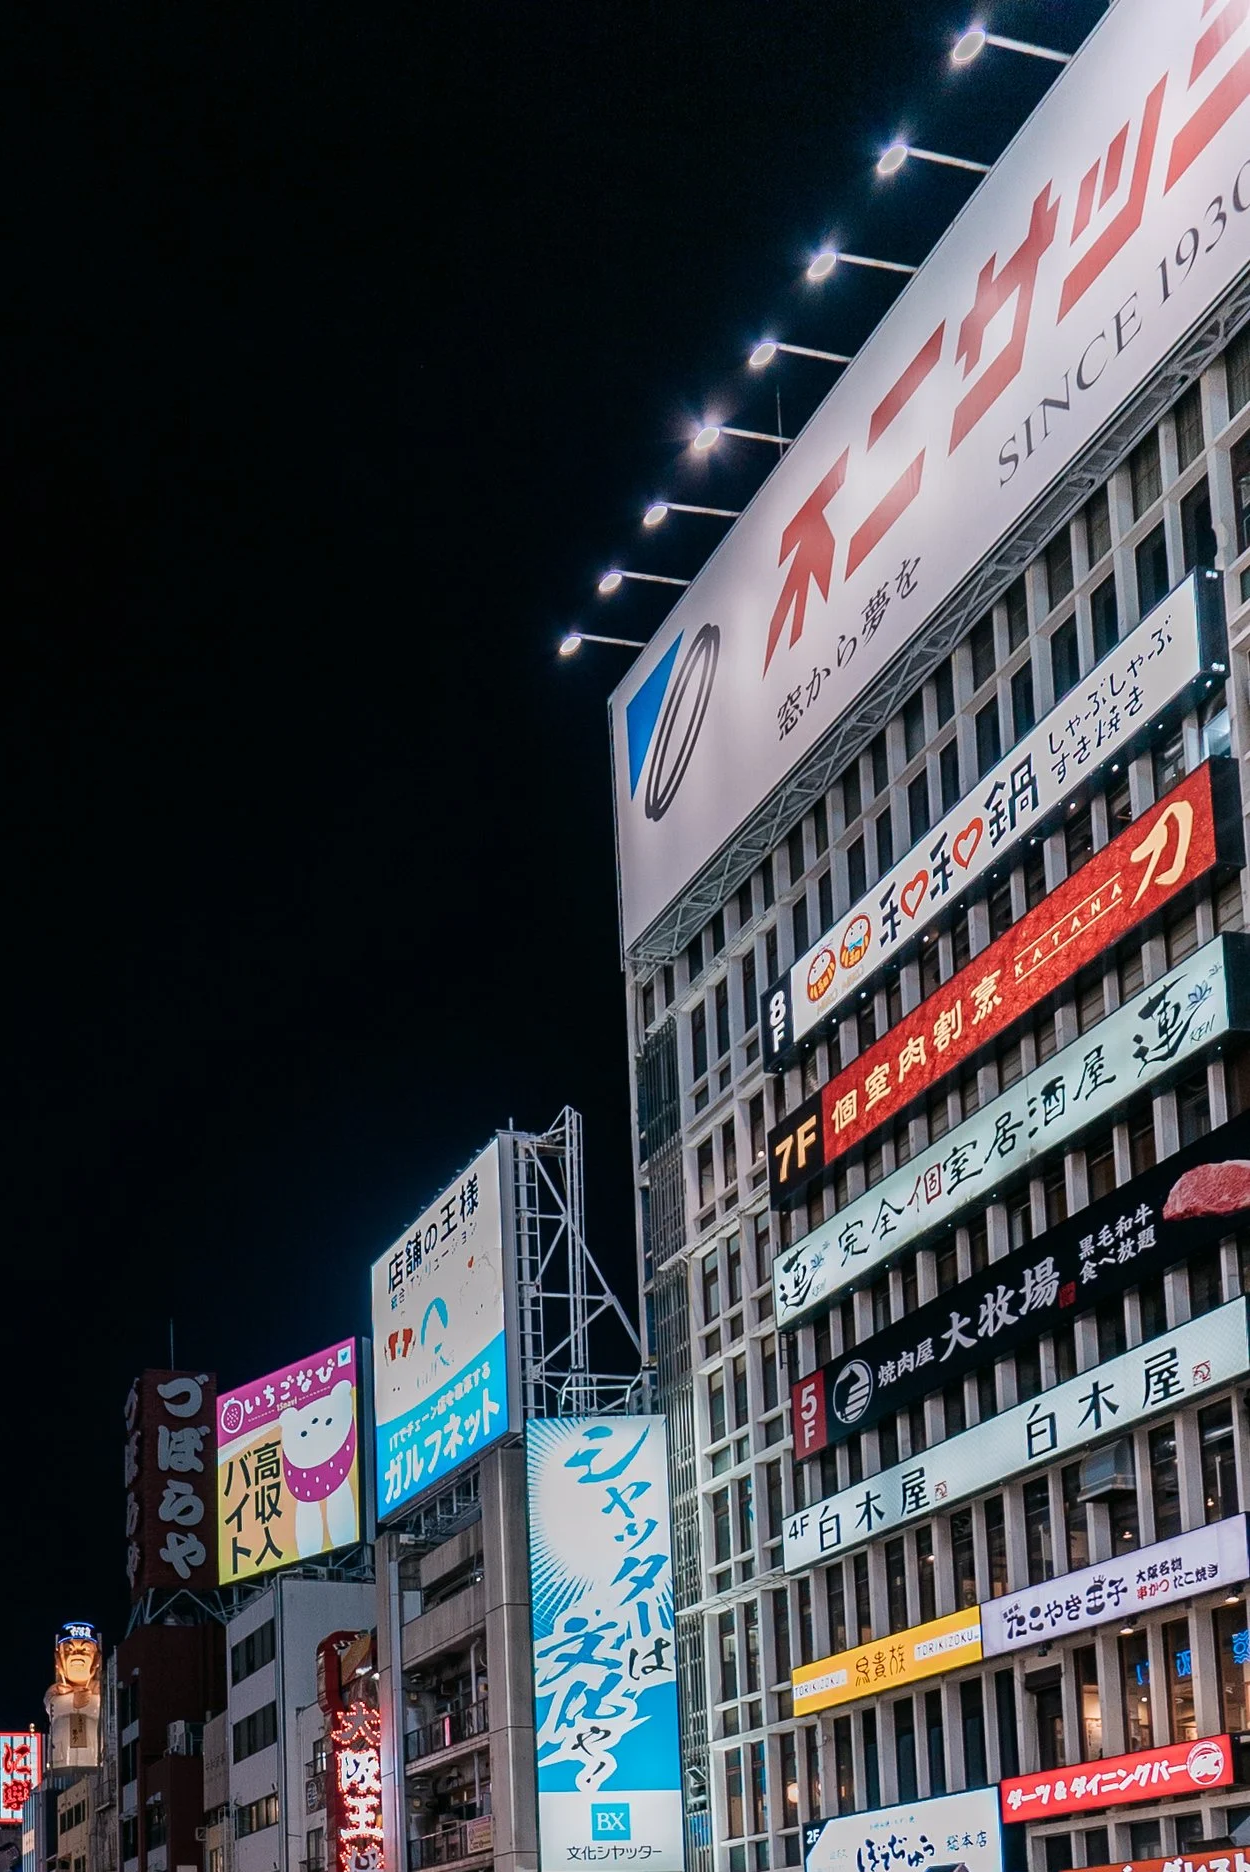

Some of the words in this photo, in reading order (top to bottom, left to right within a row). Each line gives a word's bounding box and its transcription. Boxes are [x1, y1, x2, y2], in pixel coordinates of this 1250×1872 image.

[998, 292, 1144, 487] SINCE
[777, 555, 922, 742] 窓から夢を
[1048, 614, 1173, 756] しゃぶしゃぶ
[1051, 686, 1145, 785] すき焼き
[1130, 799, 1194, 908] 刀
[1014, 883, 1123, 978] KATANA
[769, 990, 788, 1054] 8F
[831, 968, 1004, 1135] 個室肉割烹
[775, 1113, 817, 1184] 7F
[837, 1044, 1117, 1268] 完全個室居酒屋
[387, 1172, 479, 1294] 店舗の王様
[1078, 1203, 1154, 1261] 黒毛和牛
[1078, 1226, 1158, 1284] 食べ放題
[940, 1257, 1061, 1361] 大牧場
[244, 1358, 336, 1414] いちごなび
[878, 1337, 935, 1388] 焼肉屋
[801, 1382, 817, 1451] 5F
[1026, 1346, 1185, 1460] 白木屋
[157, 1373, 211, 1580] づぼらや
[384, 1387, 500, 1504] ガルフネット
[224, 1450, 252, 1576] バイト
[254, 1439, 284, 1567] 高収入
[787, 1513, 810, 1541] 4F
[817, 1466, 931, 1553] 白木屋
[1006, 1577, 1129, 1640] たこやき王子
[1135, 1557, 1183, 1585] 大阪名物
[1136, 1579, 1171, 1601] 串かつ
[1173, 1563, 1219, 1590] たこ焼き
[916, 1632, 974, 1656] TORIKIZOKU
[566, 1845, 663, 1861] 文化シヤッター
[596, 1812, 626, 1831] BX
[806, 1828, 820, 1845] 2F
[946, 1829, 988, 1851] 総本店
